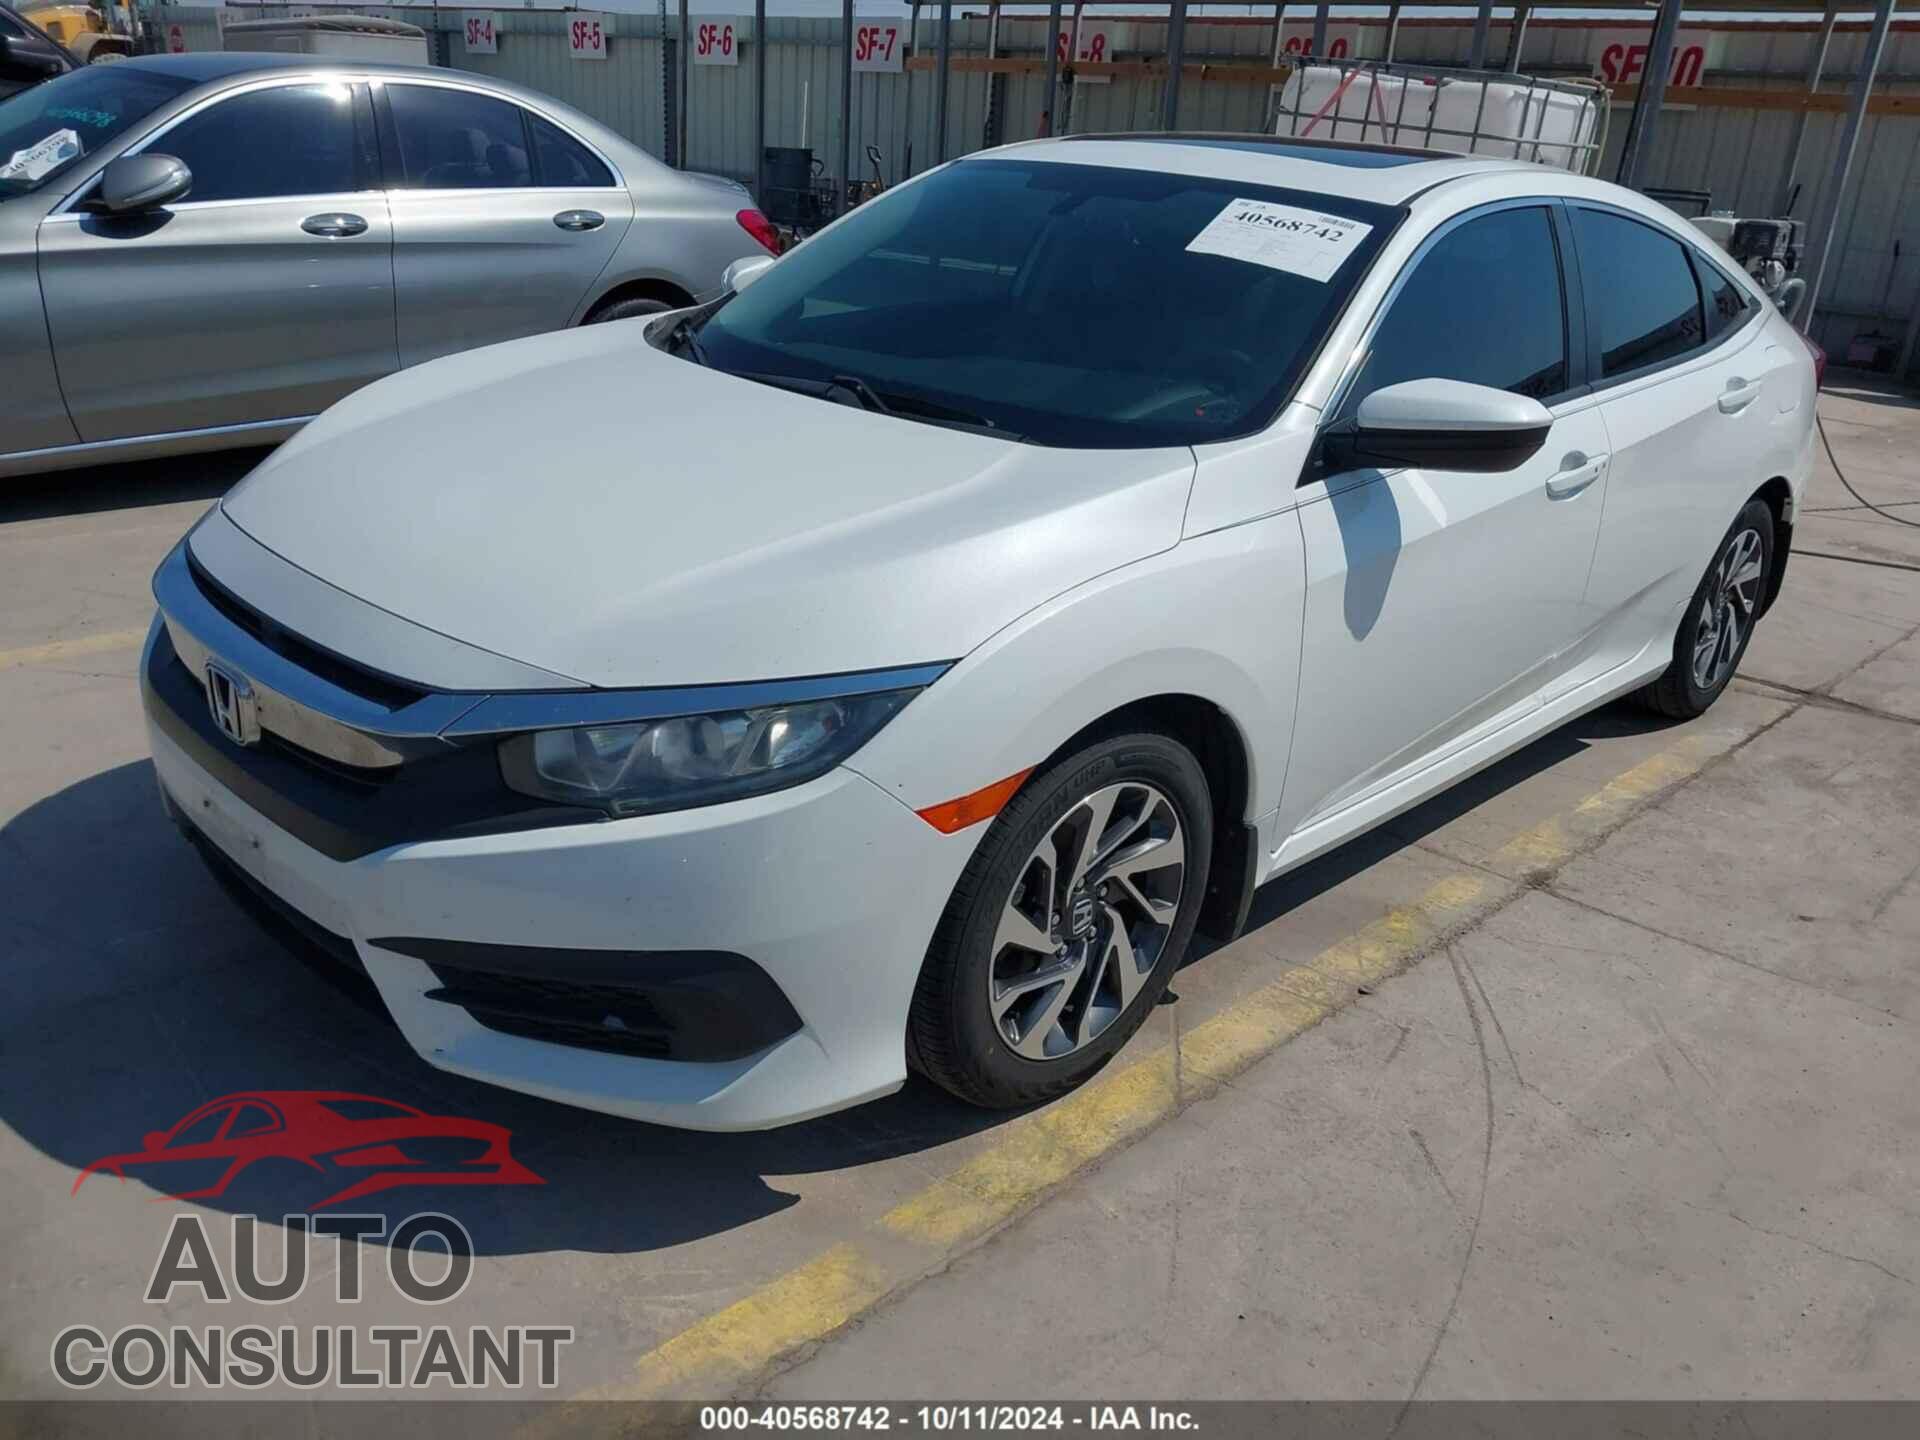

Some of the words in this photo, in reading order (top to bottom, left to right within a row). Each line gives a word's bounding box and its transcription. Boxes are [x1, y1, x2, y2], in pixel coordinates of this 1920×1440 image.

[467, 18, 492, 45] SF-4
[572, 20, 600, 50] SF-5
[698, 24, 733, 56] SF-6
[856, 27, 897, 61] SF-7
[1056, 32, 1105, 63] S-8
[1234, 211, 1344, 242] 40568742
